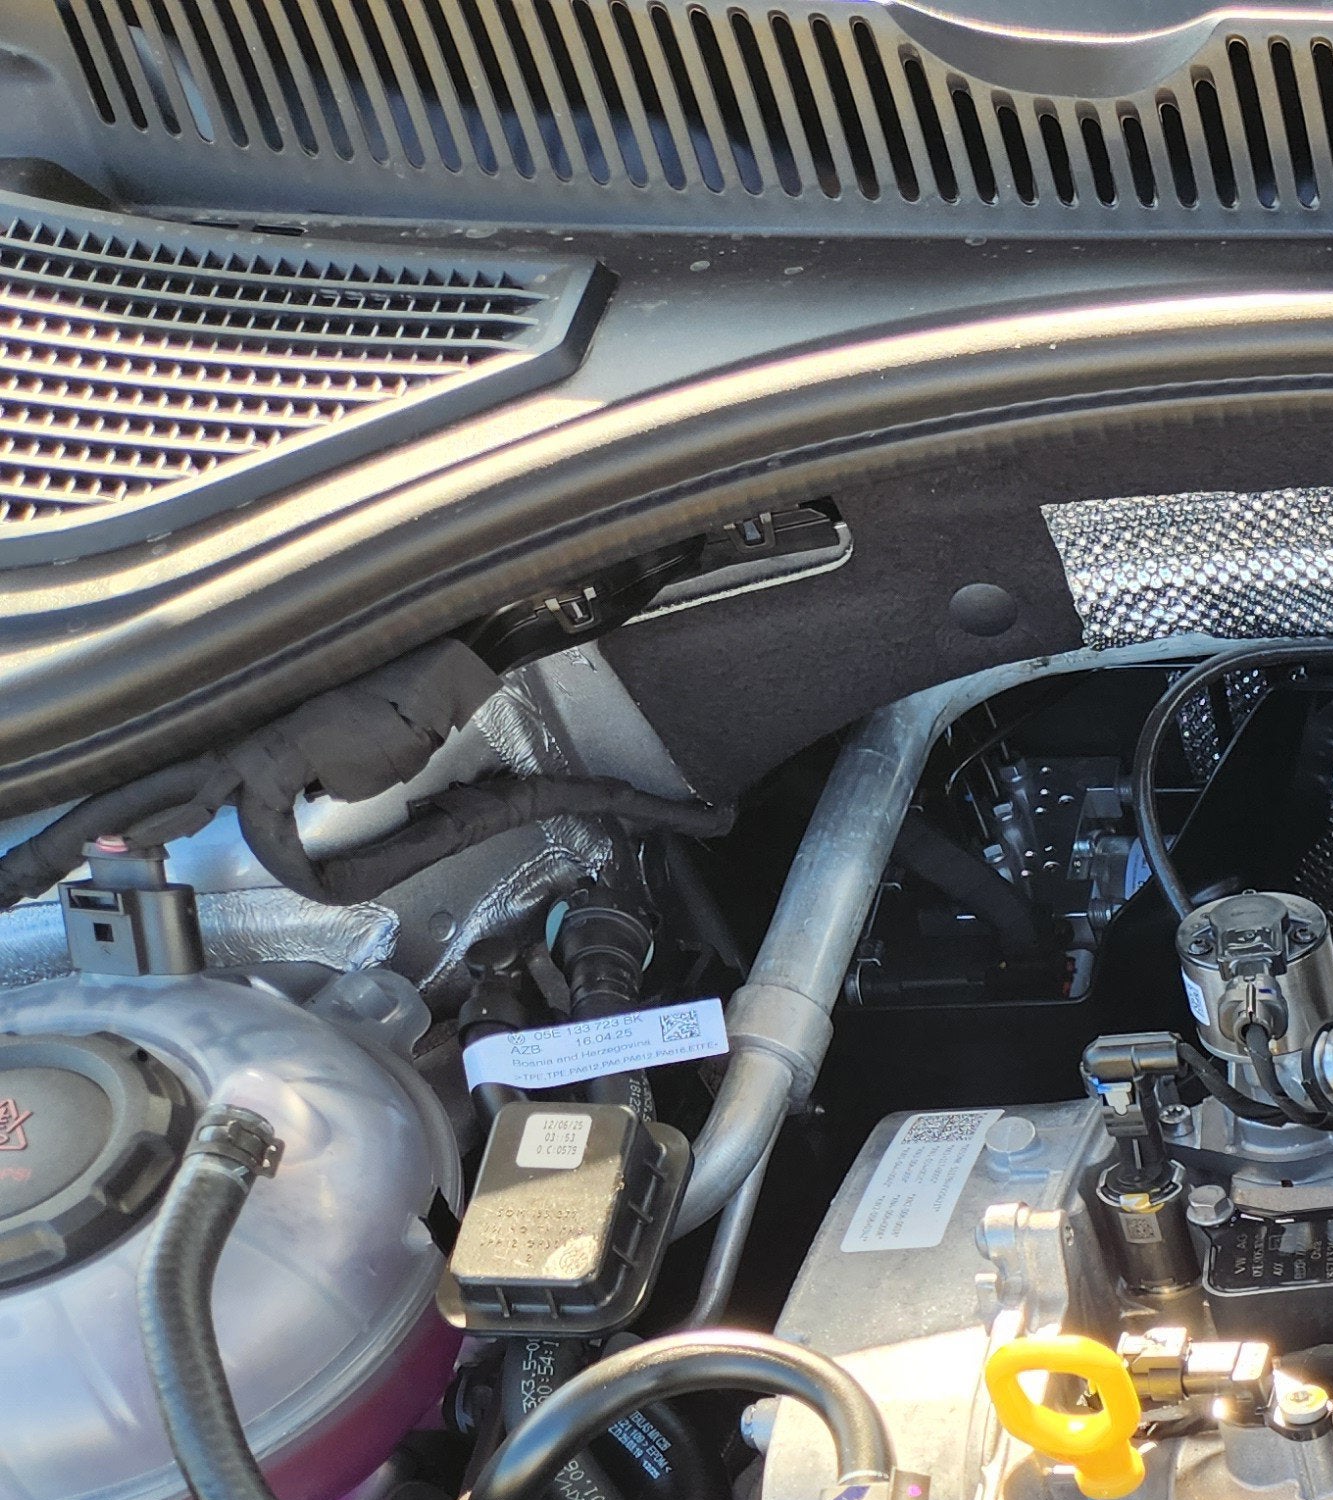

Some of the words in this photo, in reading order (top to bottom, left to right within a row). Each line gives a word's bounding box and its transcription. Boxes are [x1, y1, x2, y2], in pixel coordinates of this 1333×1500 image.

[510, 1045, 542, 1056] AZB
[576, 1028, 633, 1047] 16.04.25
[534, 1029, 561, 1041] 05E
[566, 1024, 591, 1036] 133
[595, 1018, 620, 1031] 723
[512, 1058, 554, 1069] Bosnia
[556, 1054, 579, 1066] and
[581, 1039, 651, 1061] Herzegovina
